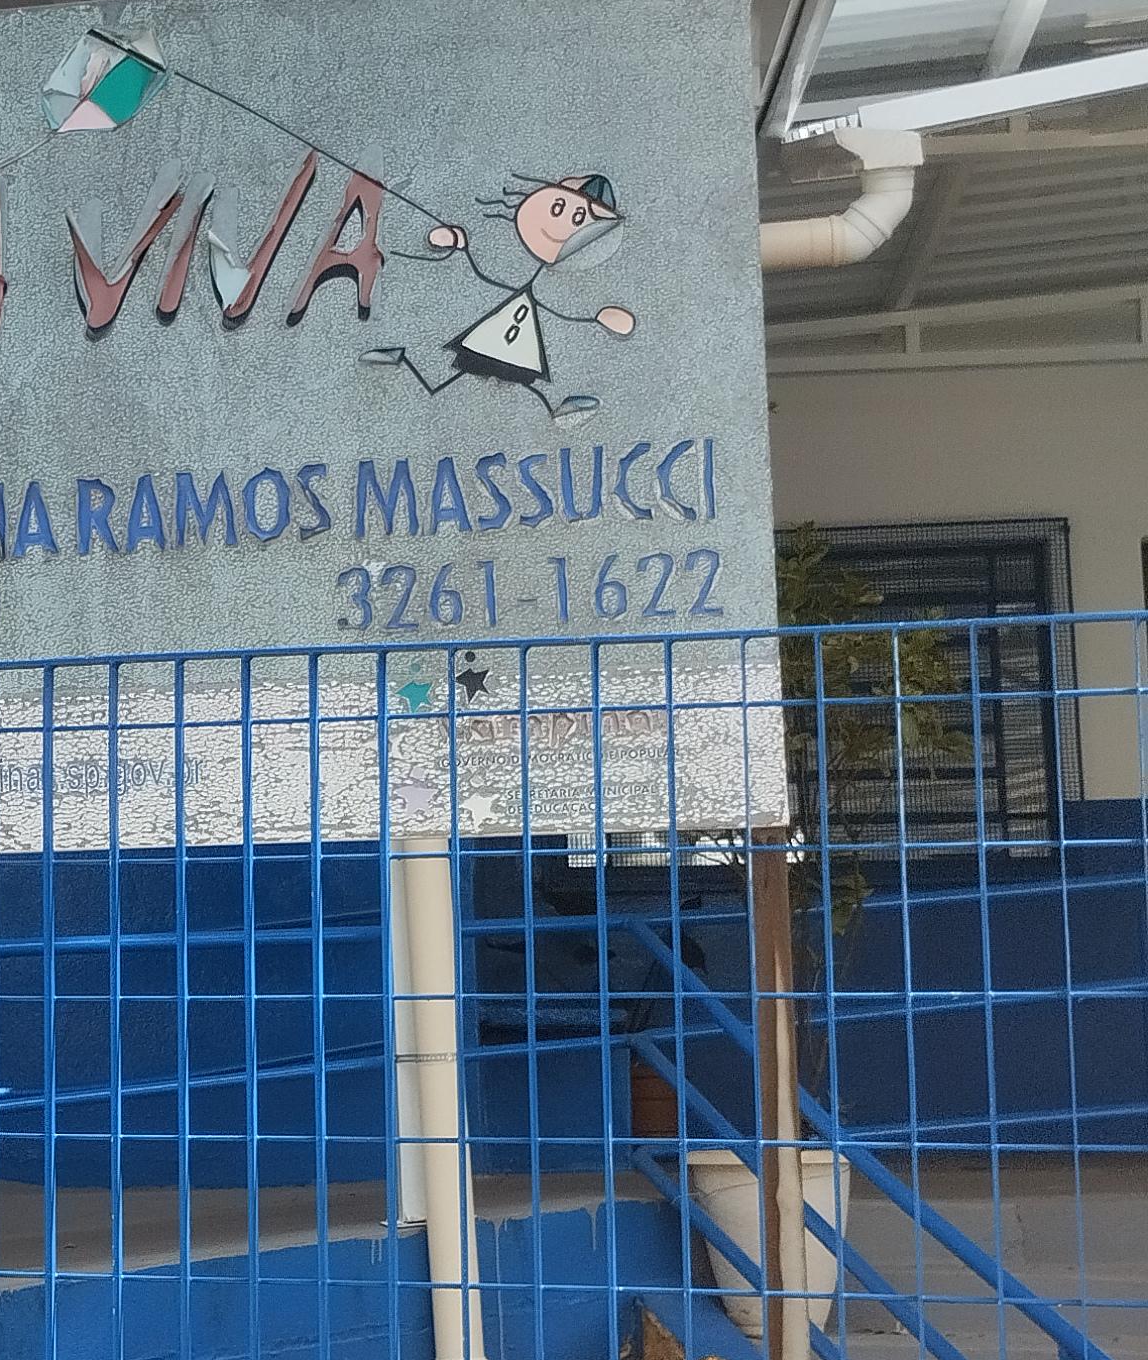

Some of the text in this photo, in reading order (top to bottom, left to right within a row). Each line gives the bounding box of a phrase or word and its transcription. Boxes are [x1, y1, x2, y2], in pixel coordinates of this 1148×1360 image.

[65, 144, 386, 342] VIVA
[76, 463, 332, 555] RAMOS
[355, 439, 718, 538] MASSUCCI
[337, 547, 725, 631] 3261-1622
[508, 784, 656, 800] SERETARIA MNICIPAL
